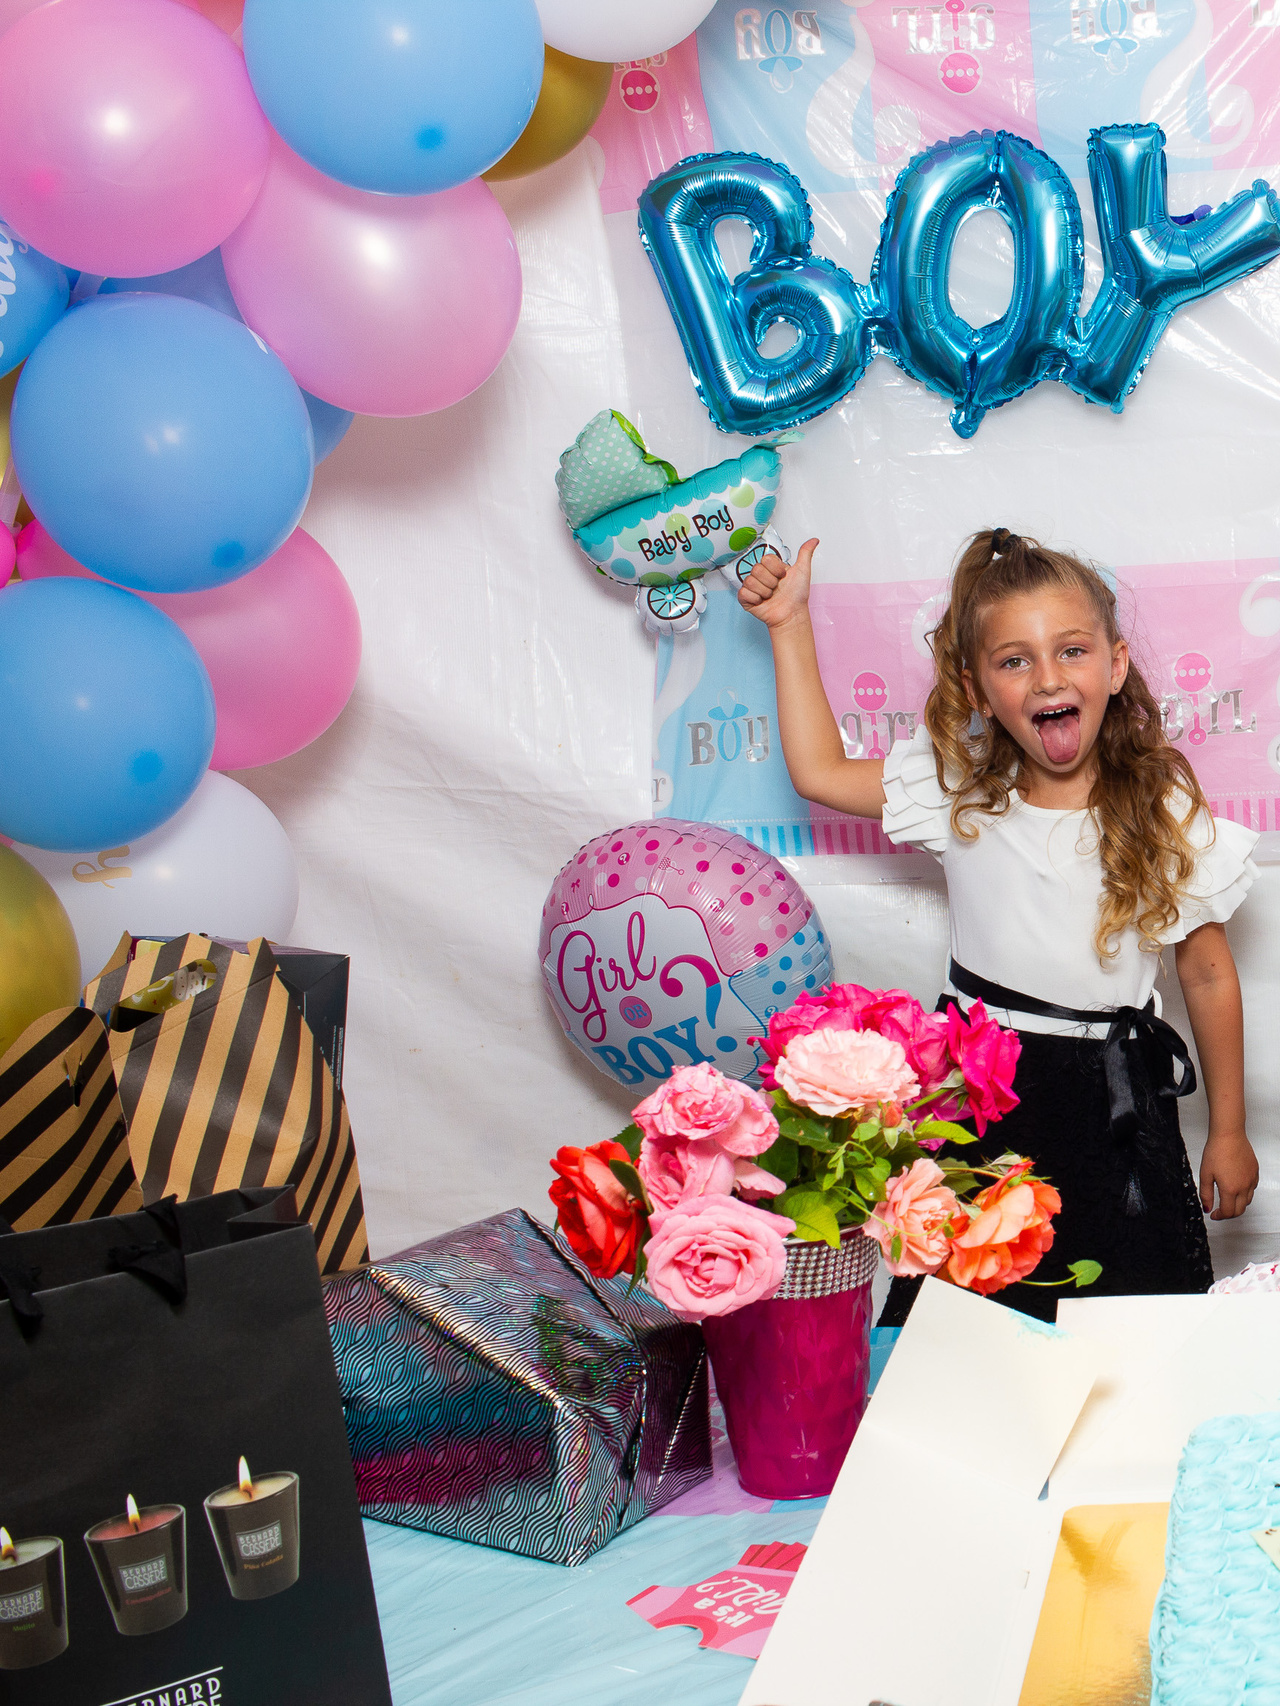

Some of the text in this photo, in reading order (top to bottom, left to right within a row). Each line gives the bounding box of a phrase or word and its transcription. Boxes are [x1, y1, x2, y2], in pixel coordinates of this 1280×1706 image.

[638, 504, 735, 562] Baby Boy
[557, 911, 657, 1043] Girl
[623, 1003, 648, 1022] OR
[590, 1015, 717, 1086] BOY
[240, 1526, 280, 1545] BERNARD
[122, 1560, 165, 1578] BERNARD
[693, 1597, 755, 1628] It's a
